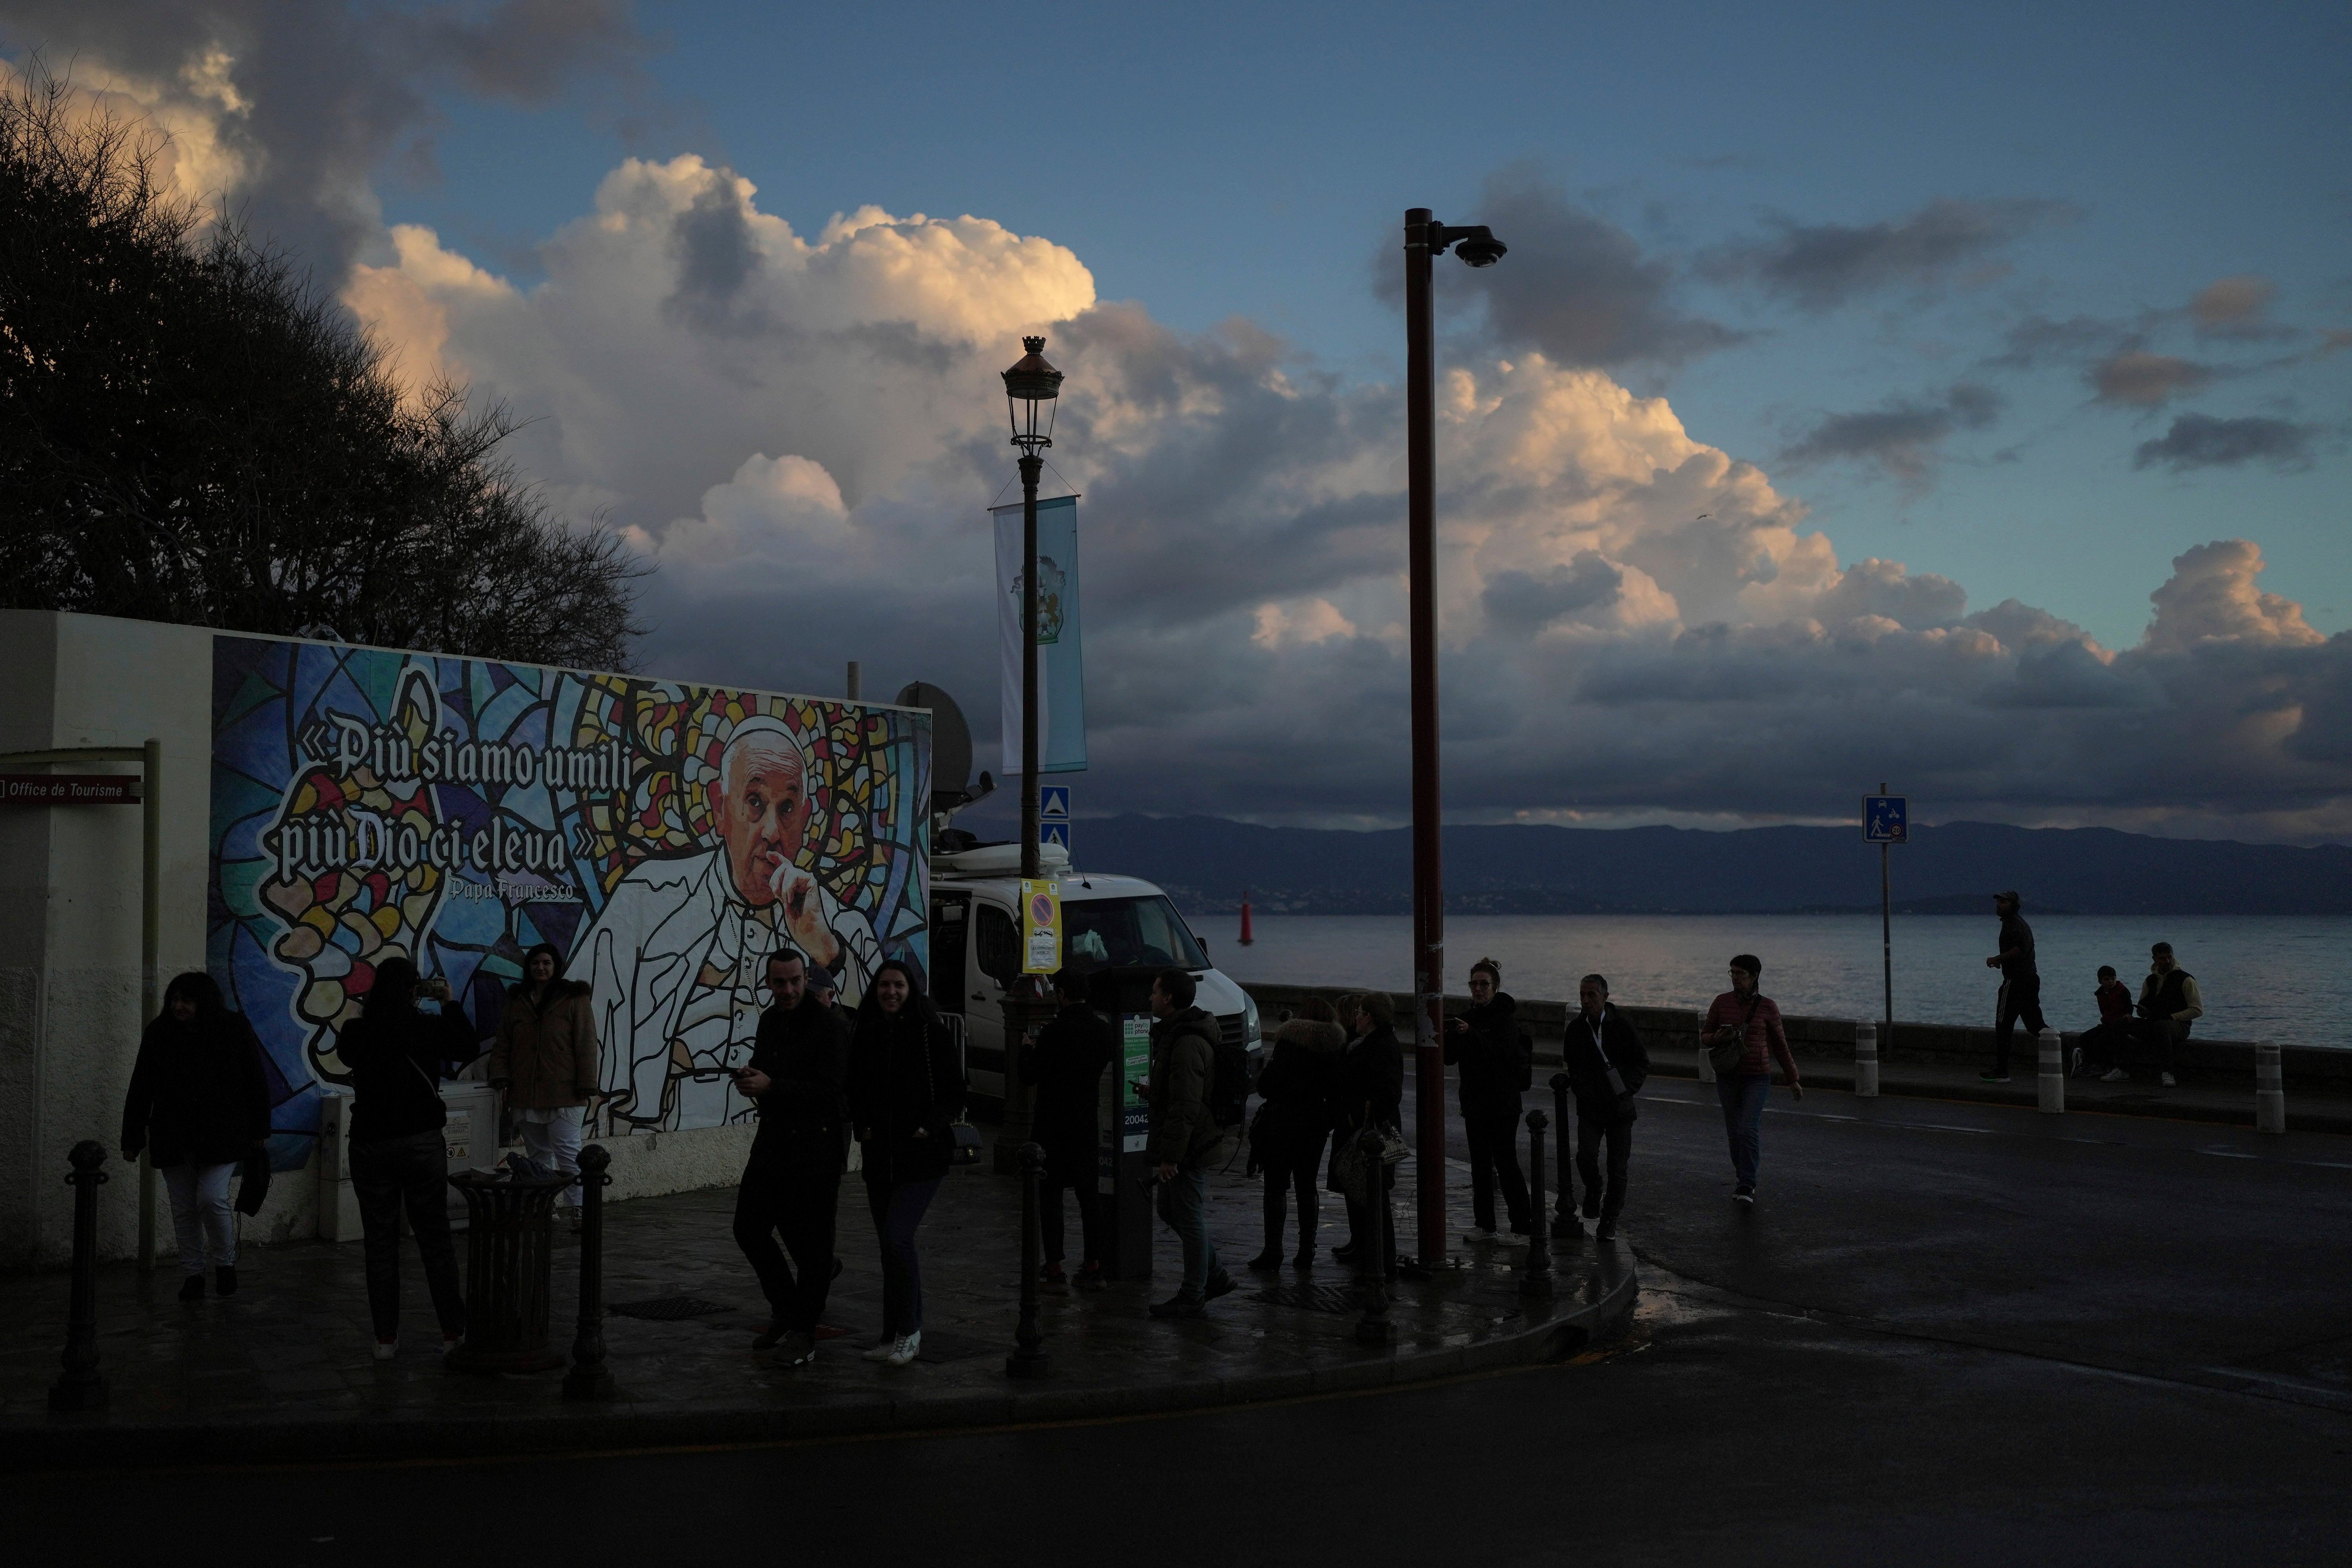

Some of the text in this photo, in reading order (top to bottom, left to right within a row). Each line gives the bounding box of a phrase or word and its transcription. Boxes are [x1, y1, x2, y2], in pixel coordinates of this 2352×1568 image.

[423, 731, 532, 784] siamo
[544, 740, 632, 791] umili
[10, 782, 122, 797] Office de Tourisme
[281, 808, 348, 884] più
[347, 807, 417, 869] Dio
[430, 819, 463, 868] ci
[448, 875, 573, 904] Papa Francesco
[1125, 1114, 1149, 1125] 20042
[1098, 1157, 1112, 1167] 042
